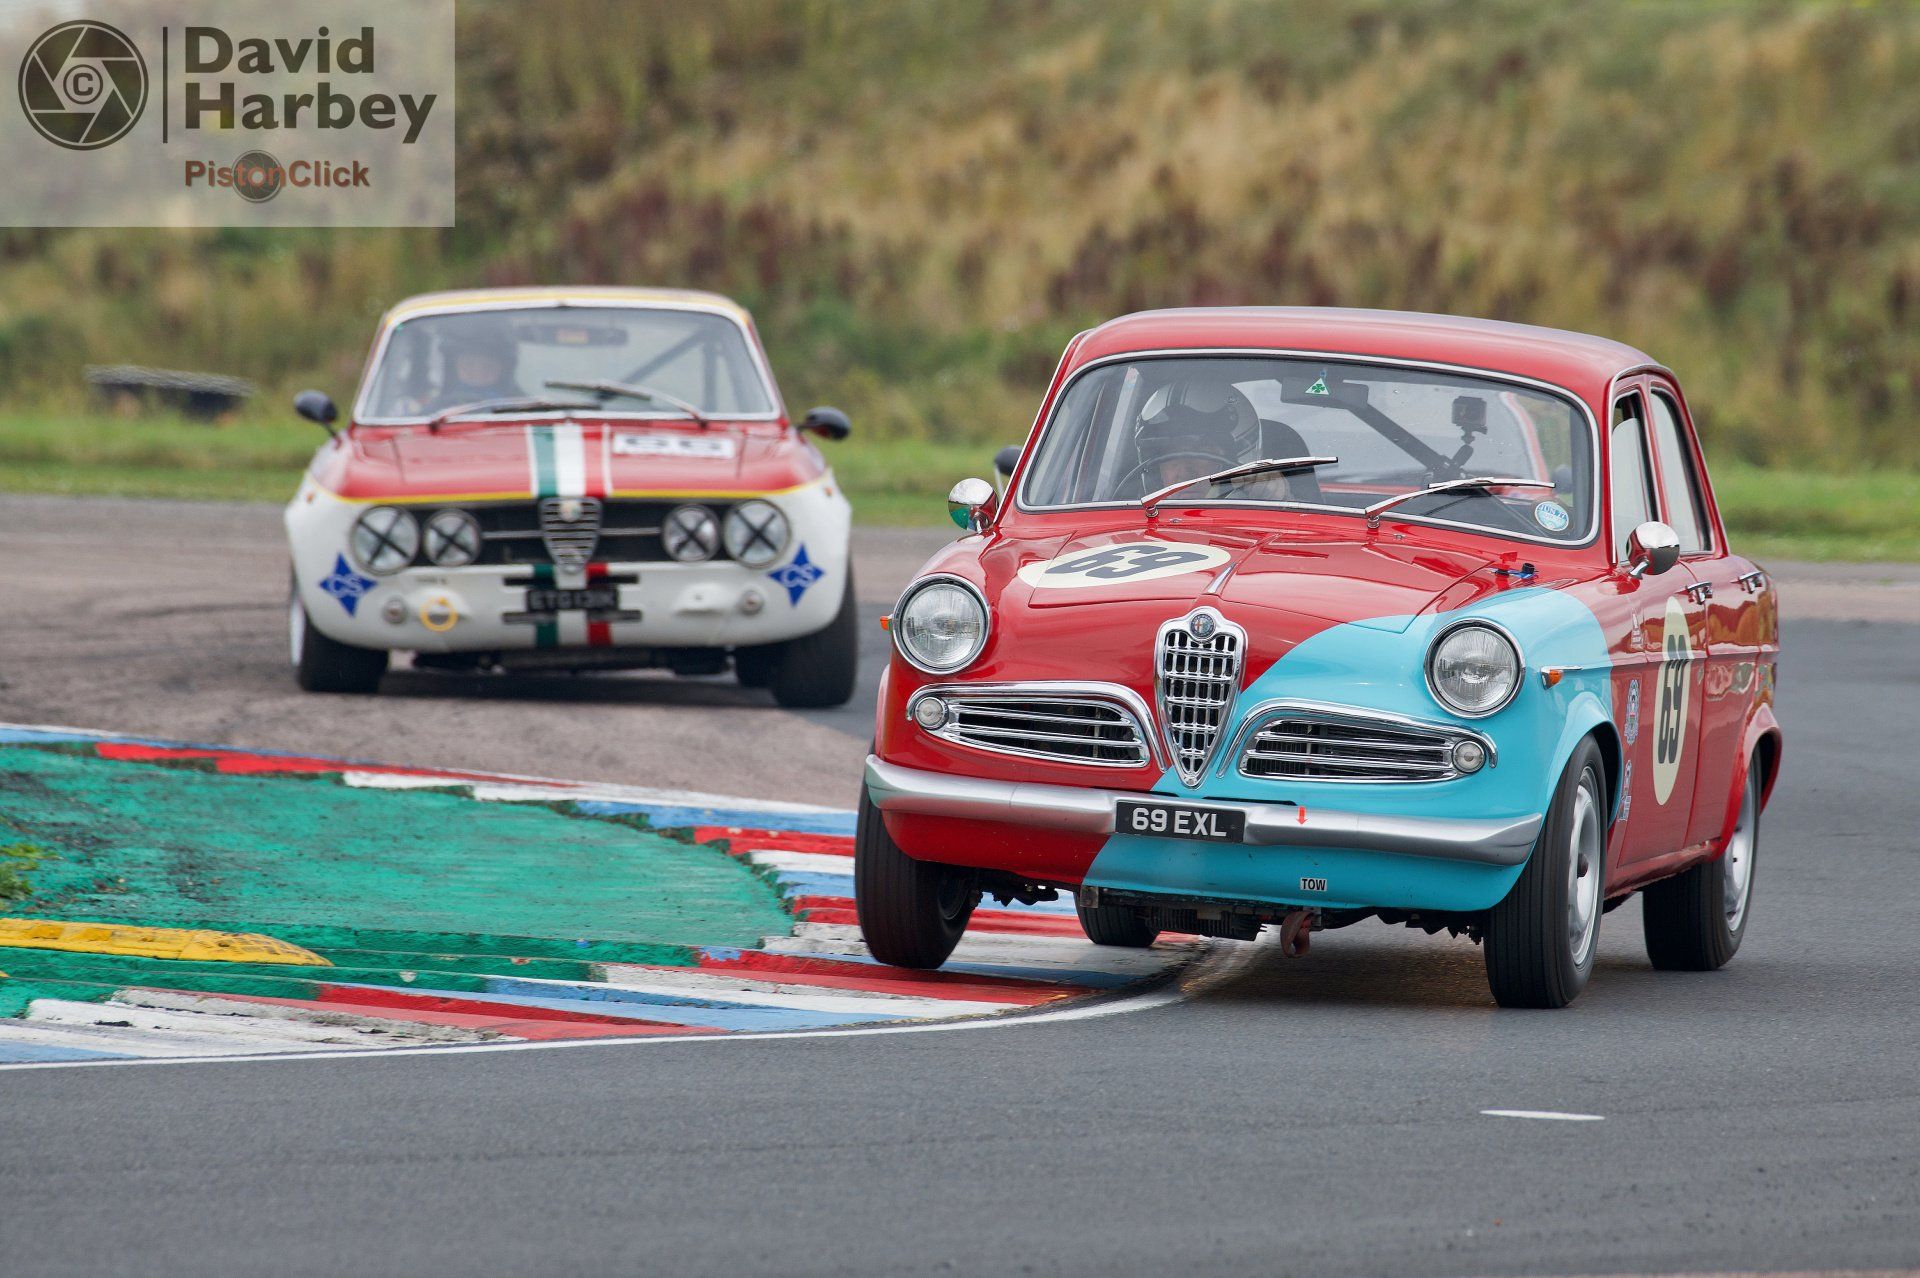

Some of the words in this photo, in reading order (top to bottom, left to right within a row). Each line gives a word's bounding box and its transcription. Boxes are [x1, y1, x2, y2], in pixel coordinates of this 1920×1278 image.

[1044, 545, 1210, 579] 69
[1657, 634, 1692, 764] 69
[1132, 807, 1168, 832] 69
[1173, 811, 1227, 837] EXL
[1302, 878, 1326, 891] TOW
